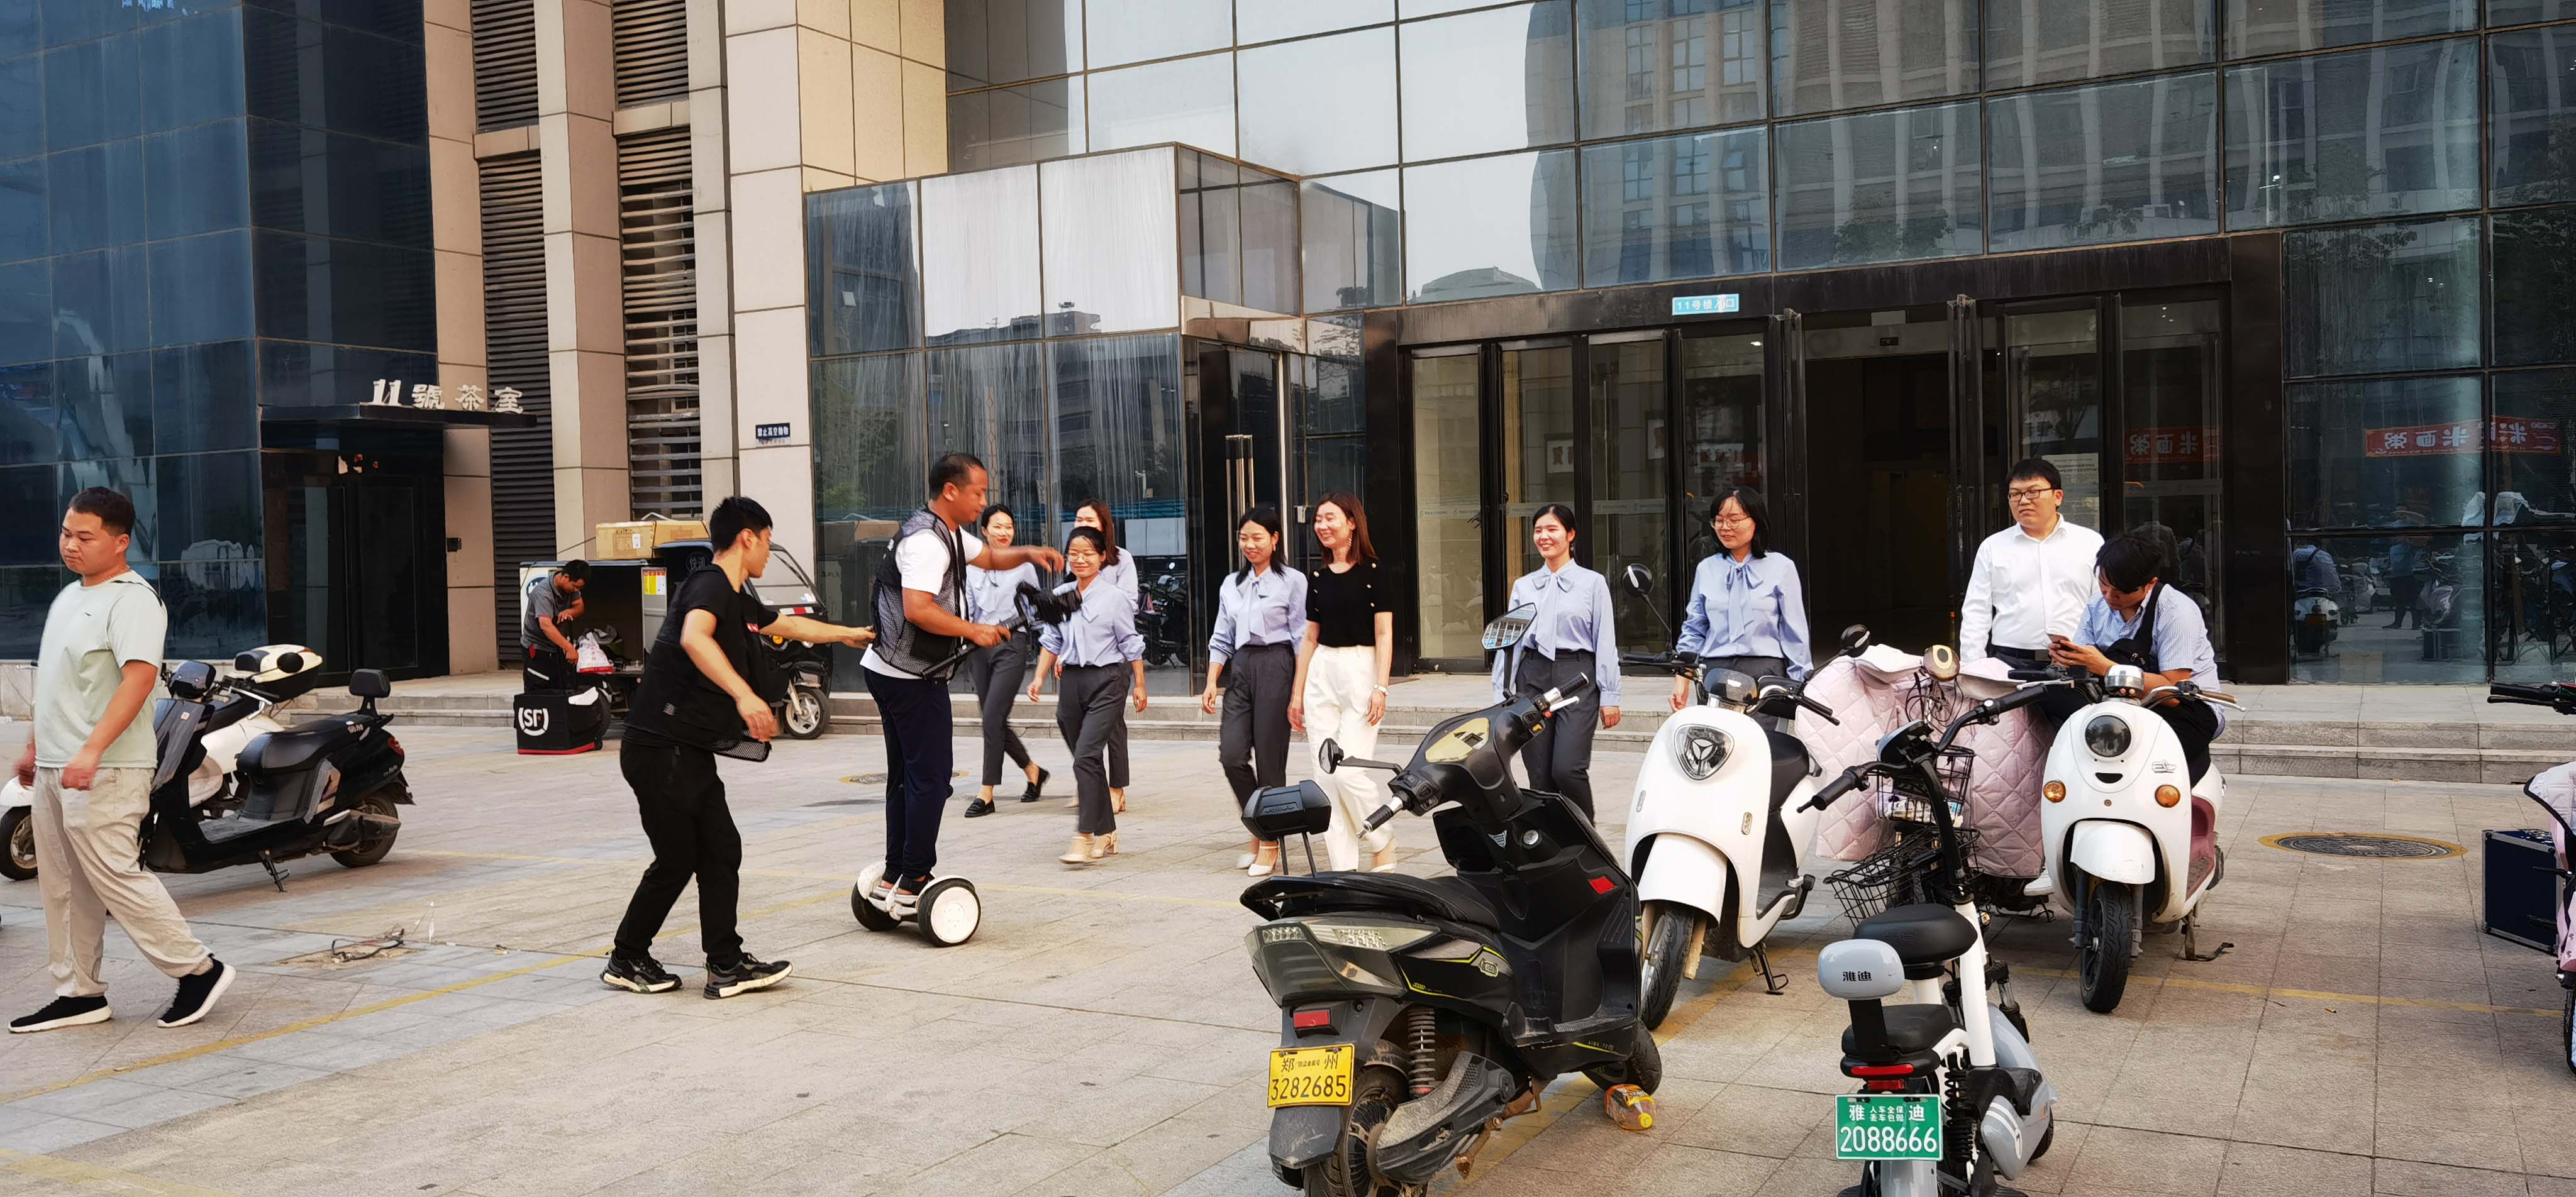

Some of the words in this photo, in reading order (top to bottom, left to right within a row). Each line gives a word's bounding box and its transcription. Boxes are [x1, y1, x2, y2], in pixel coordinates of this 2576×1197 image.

[1843, 971, 1872, 982] 雅迪
[1271, 1074, 1346, 1101] 3282685
[1869, 1105, 1904, 1114] 人车全保
[1869, 1113, 1904, 1122] 丢车包赔
[1840, 1126, 1938, 1152] 2088666
